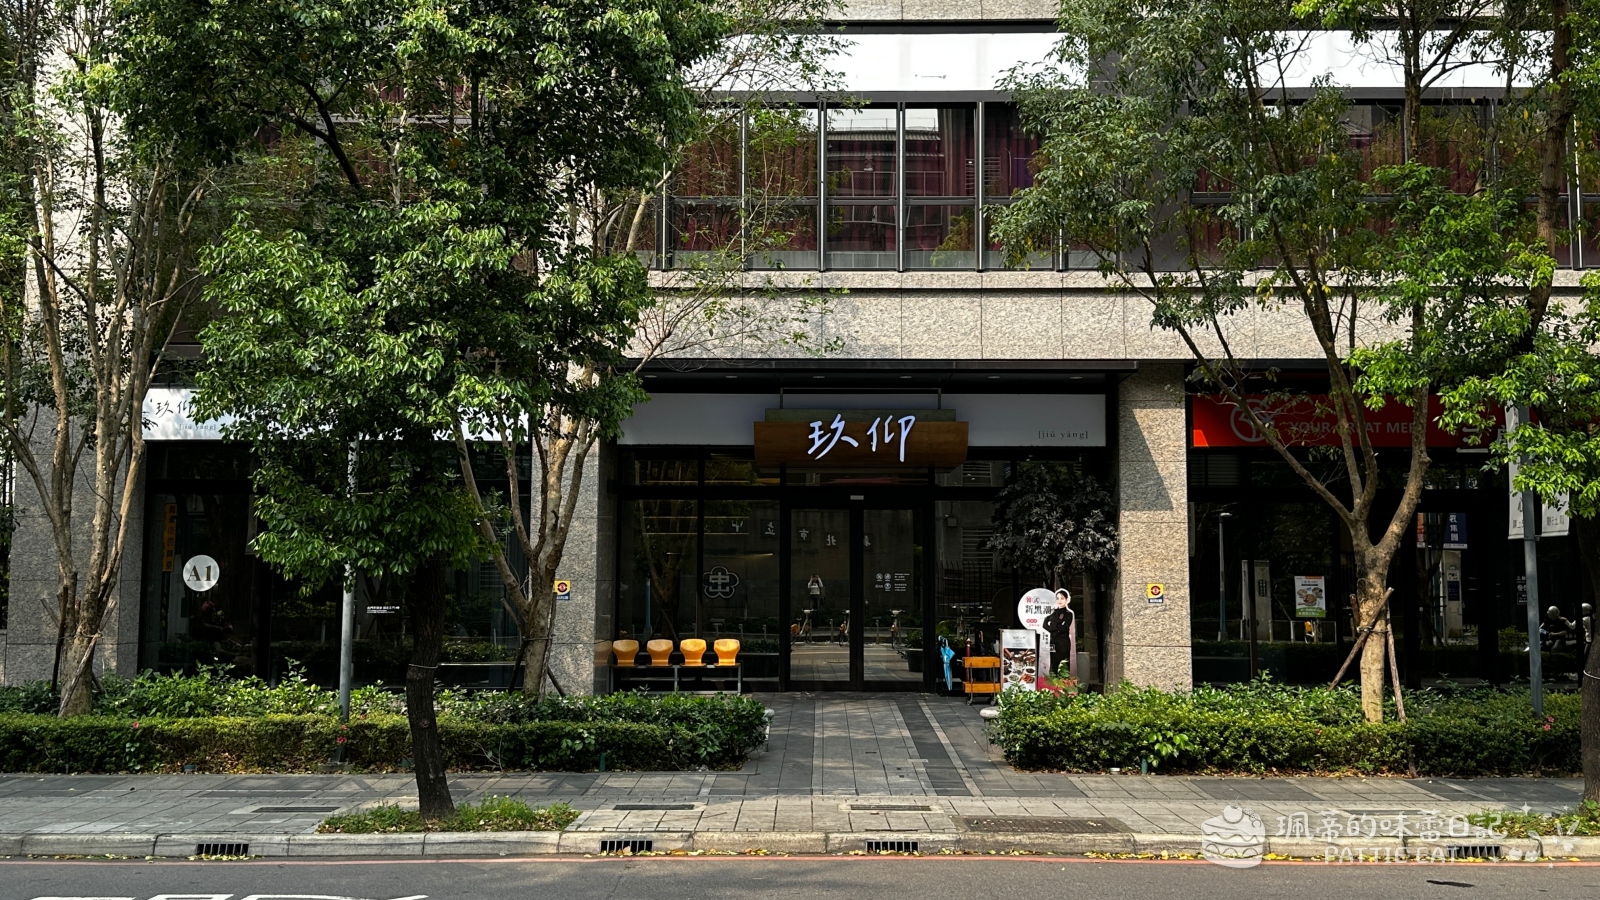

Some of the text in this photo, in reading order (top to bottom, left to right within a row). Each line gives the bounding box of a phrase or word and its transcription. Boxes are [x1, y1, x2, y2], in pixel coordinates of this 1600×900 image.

[1288, 421, 1331, 434] YOUR
[807, 413, 916, 463] 玖仰
[187, 565, 213, 582] A1
